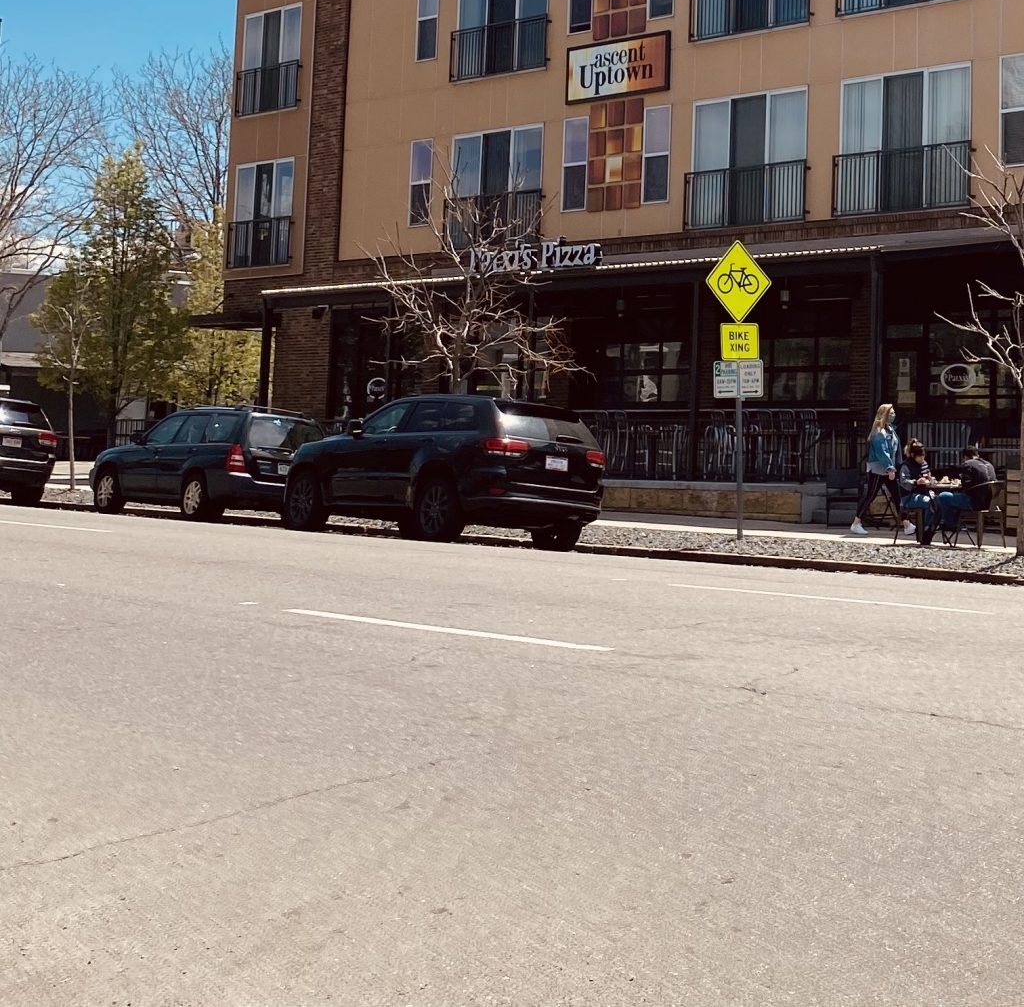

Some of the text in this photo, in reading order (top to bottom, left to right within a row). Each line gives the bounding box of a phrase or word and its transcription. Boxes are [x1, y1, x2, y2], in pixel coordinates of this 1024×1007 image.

[594, 40, 646, 68] ascent
[579, 63, 653, 96] Uptown
[541, 237, 600, 268] Pizza
[728, 331, 750, 341] BIKE
[730, 343, 750, 352] XING
[715, 364, 721, 375] 2
